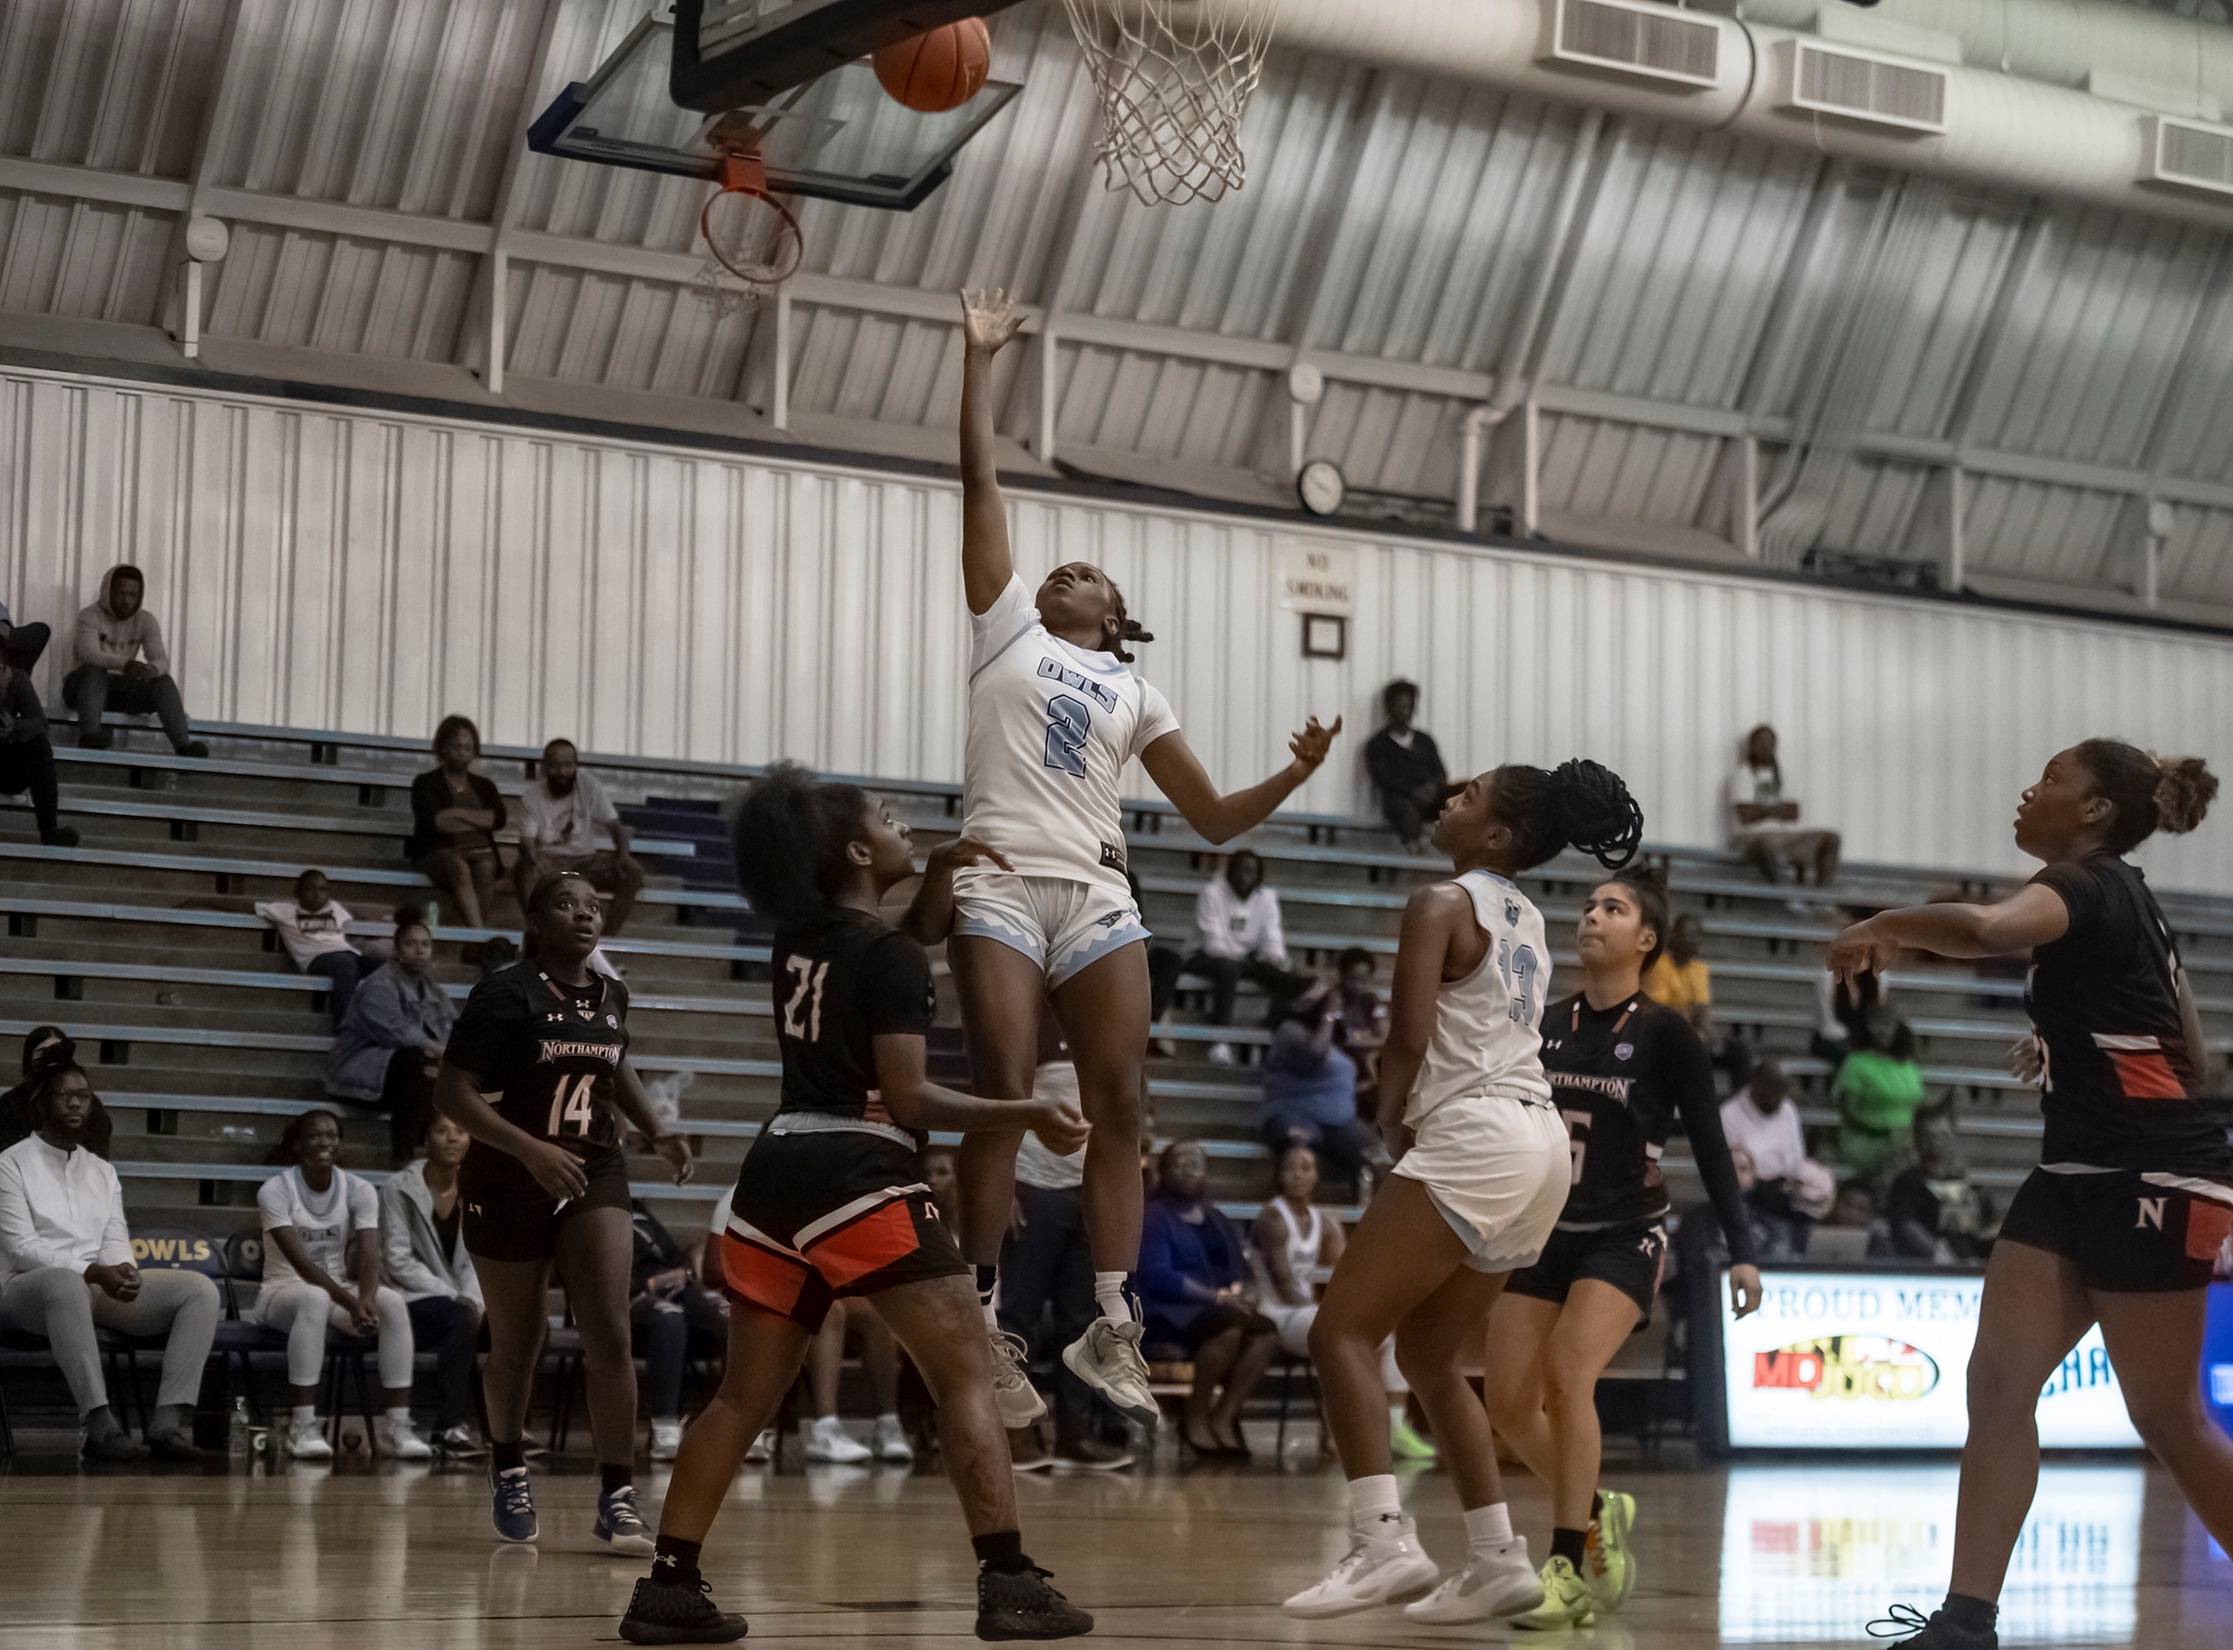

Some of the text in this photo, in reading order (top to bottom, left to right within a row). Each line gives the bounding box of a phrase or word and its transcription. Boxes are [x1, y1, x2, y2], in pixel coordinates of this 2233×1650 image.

[1037, 656, 1119, 715] OWLS
[1044, 693, 1091, 779] 2
[784, 953, 831, 1042] 21
[539, 1039, 623, 1067] NORTHAMPTON
[547, 1073, 597, 1136] 14
[2134, 1197, 2170, 1232] N
[130, 1238, 211, 1262] OWLS
